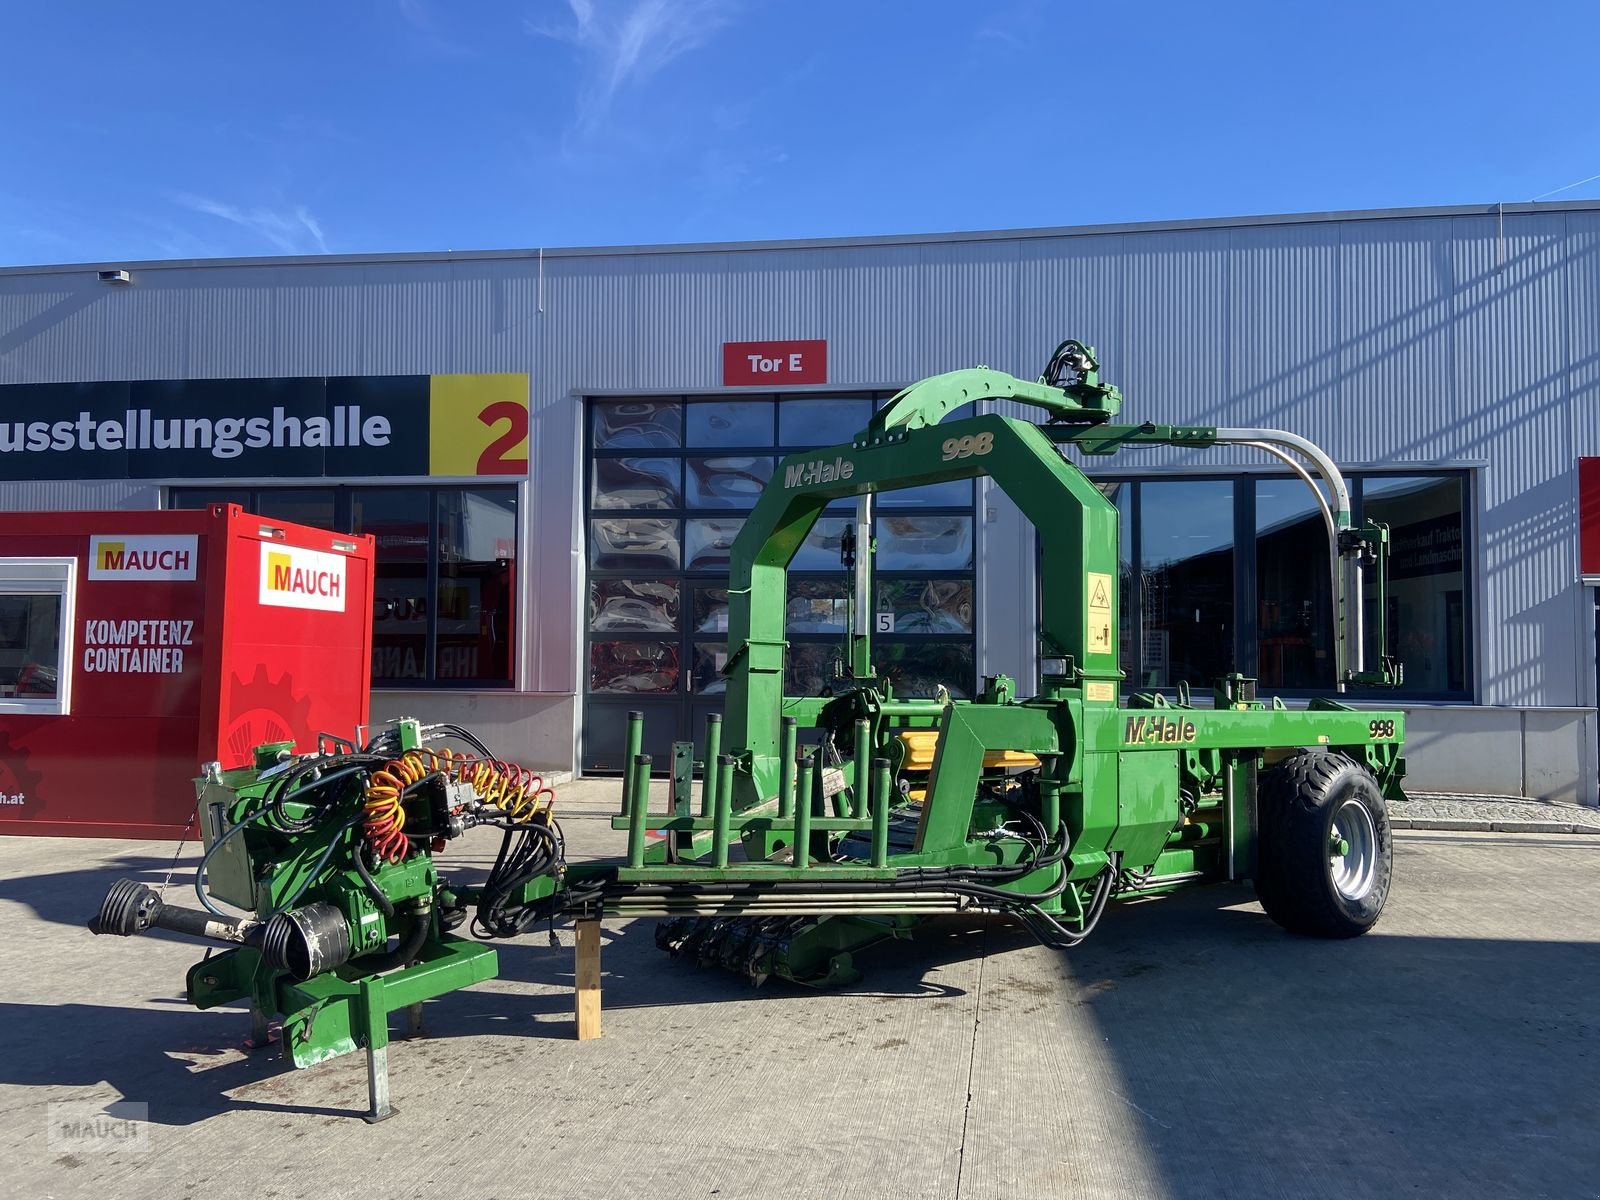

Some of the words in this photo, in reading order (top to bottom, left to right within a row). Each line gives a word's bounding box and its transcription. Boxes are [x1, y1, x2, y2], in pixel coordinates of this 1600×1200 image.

[748, 354, 782, 373] Tor
[789, 354, 803, 372] E
[476, 401, 528, 475] 2
[942, 431, 994, 461] 998
[784, 457, 854, 488] McHale
[104, 550, 190, 571] MAUCH
[273, 564, 341, 598] MAUCH
[85, 619, 194, 646] KOMPETENZ
[879, 615, 891, 631] 5
[84, 647, 184, 673] CONTAINER
[1125, 716, 1196, 744] McHale
[1369, 719, 1395, 739] 998
